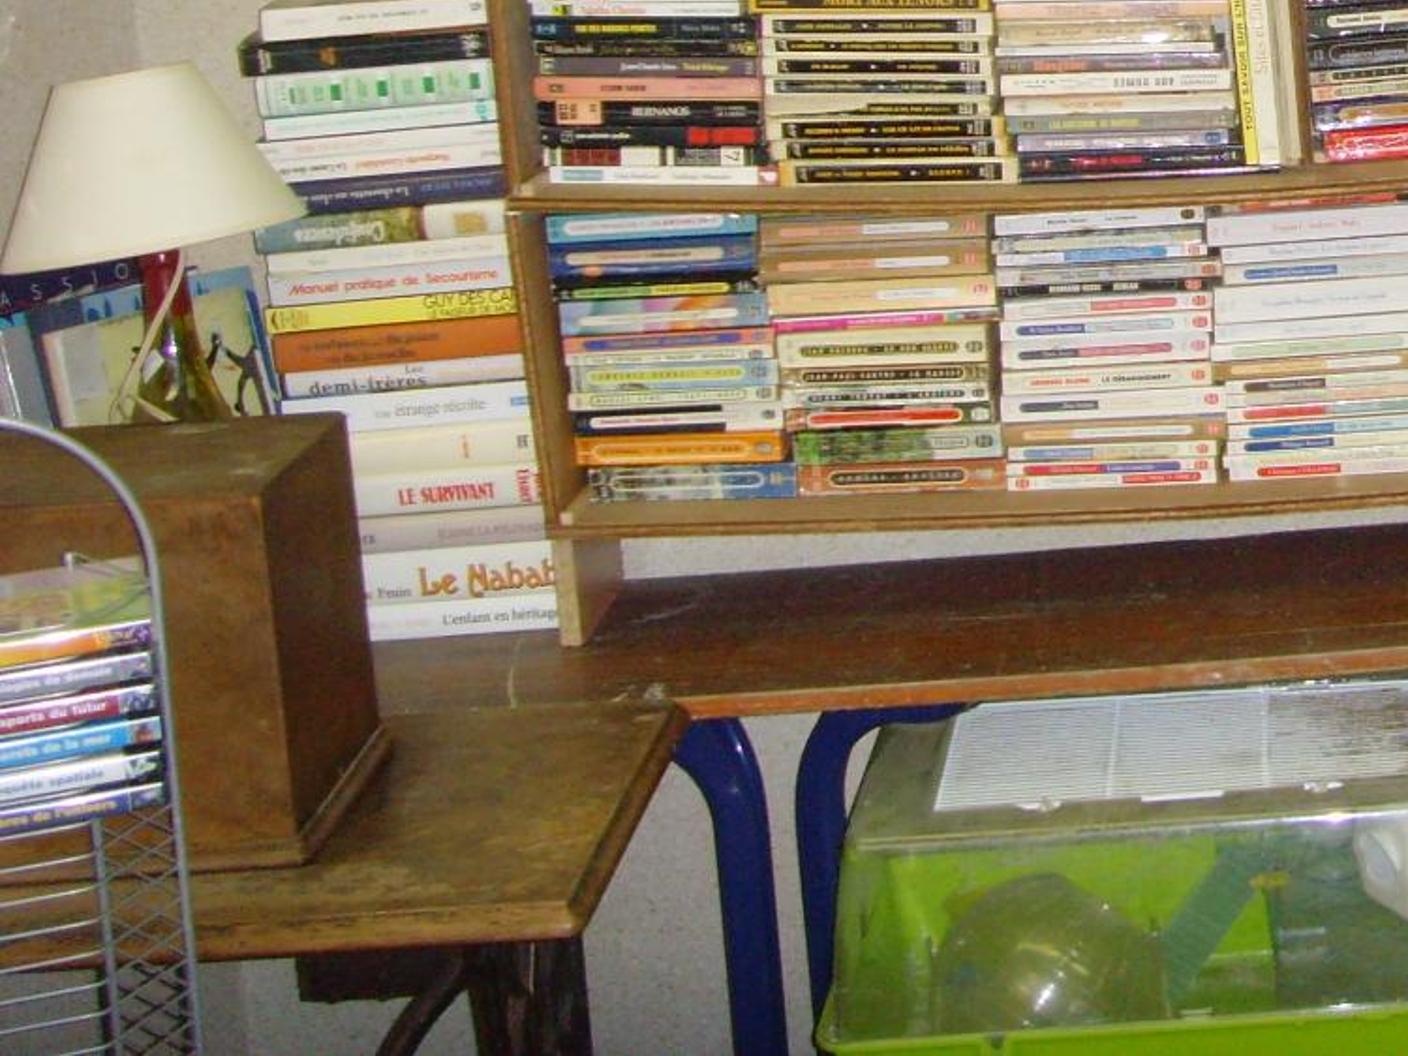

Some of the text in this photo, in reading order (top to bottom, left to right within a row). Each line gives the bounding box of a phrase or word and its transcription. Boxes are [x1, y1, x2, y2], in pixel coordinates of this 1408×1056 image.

[1235, 21, 1247, 46] SUR
[1241, 99, 1253, 131] TOUT
[288, 279, 339, 296] Manuel
[344, 277, 397, 294] pratique
[402, 275, 419, 287] de
[422, 292, 486, 308] GUY DES
[308, 375, 429, 396] demi-frères
[397, 488, 418, 507] LE
[419, 481, 495, 504] SURVIVANT
[417, 564, 459, 597] Le
[442, 612, 510, 627] L'enfant en
[72, 701, 108, 716] futur
